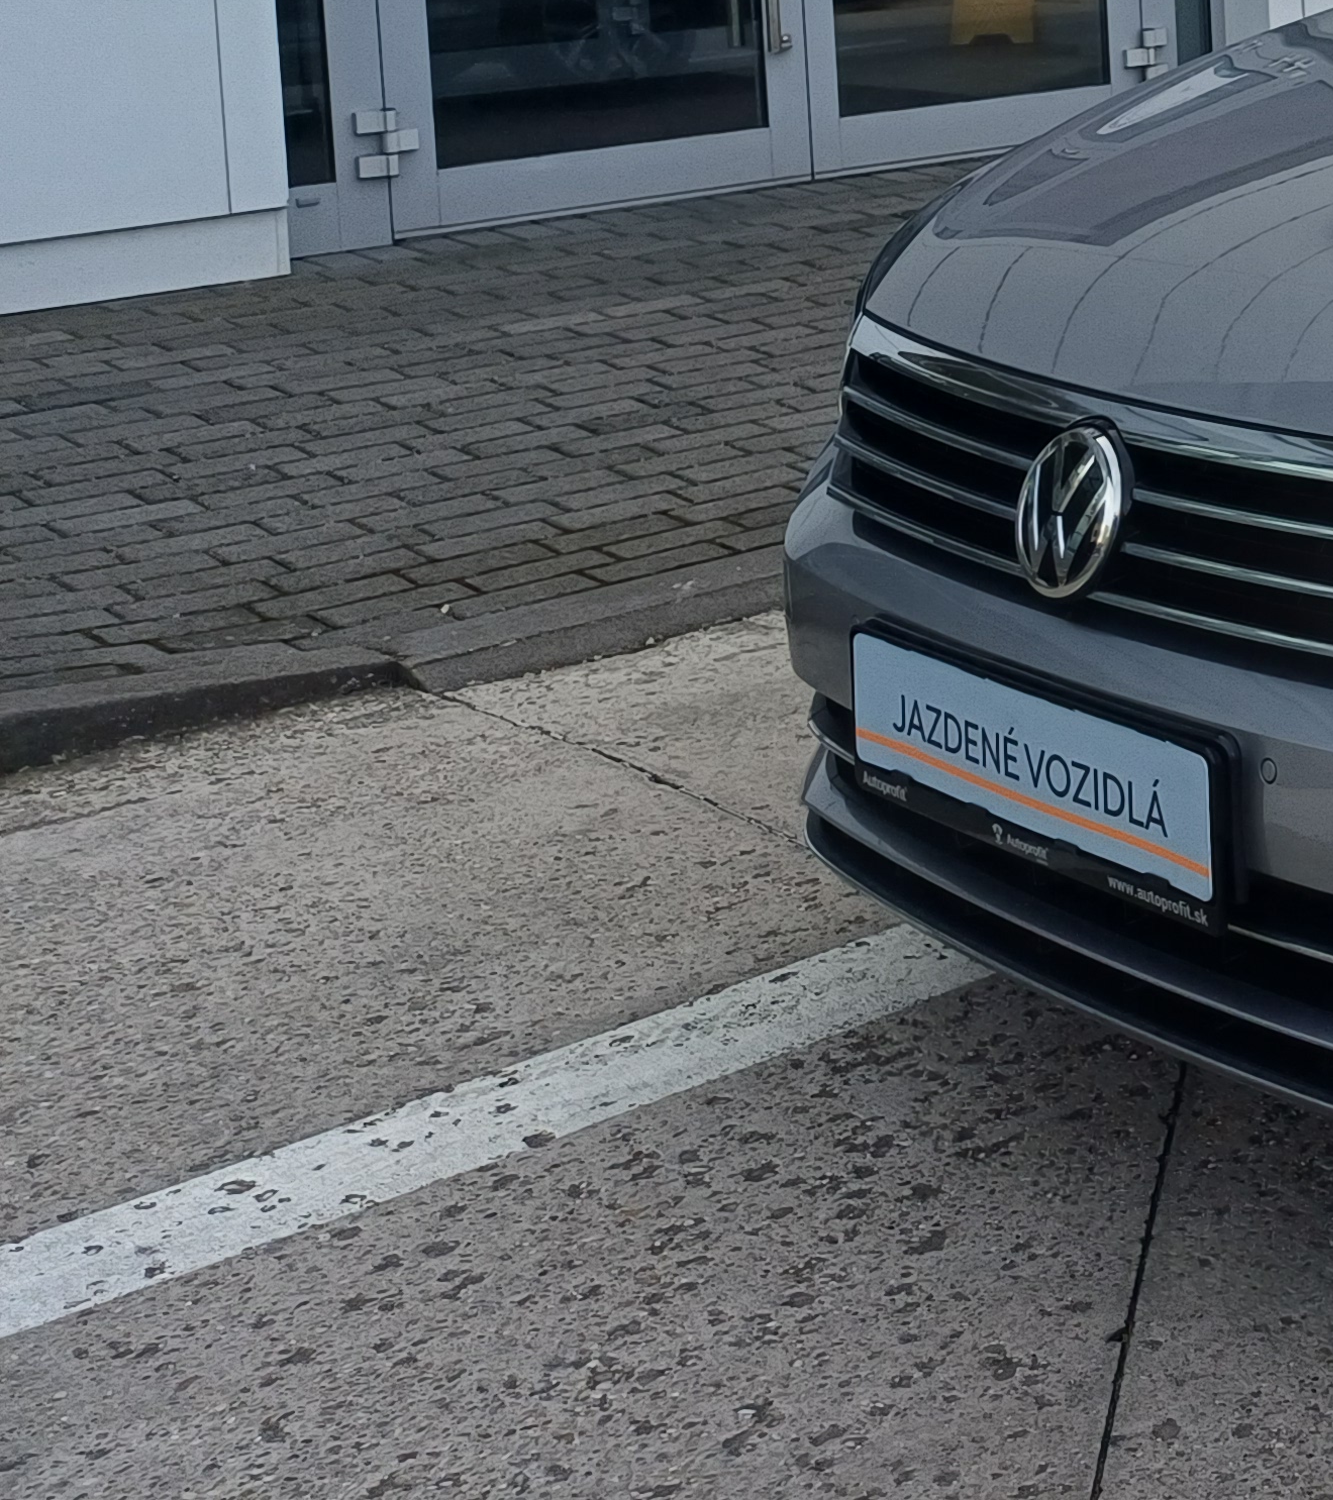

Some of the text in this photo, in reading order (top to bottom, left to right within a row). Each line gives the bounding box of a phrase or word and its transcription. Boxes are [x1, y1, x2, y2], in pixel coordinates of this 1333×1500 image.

[892, 694, 1169, 838] JAZDENÉ VOZIDLÁ
[1106, 874, 1210, 928] www.autoprofit.sk
